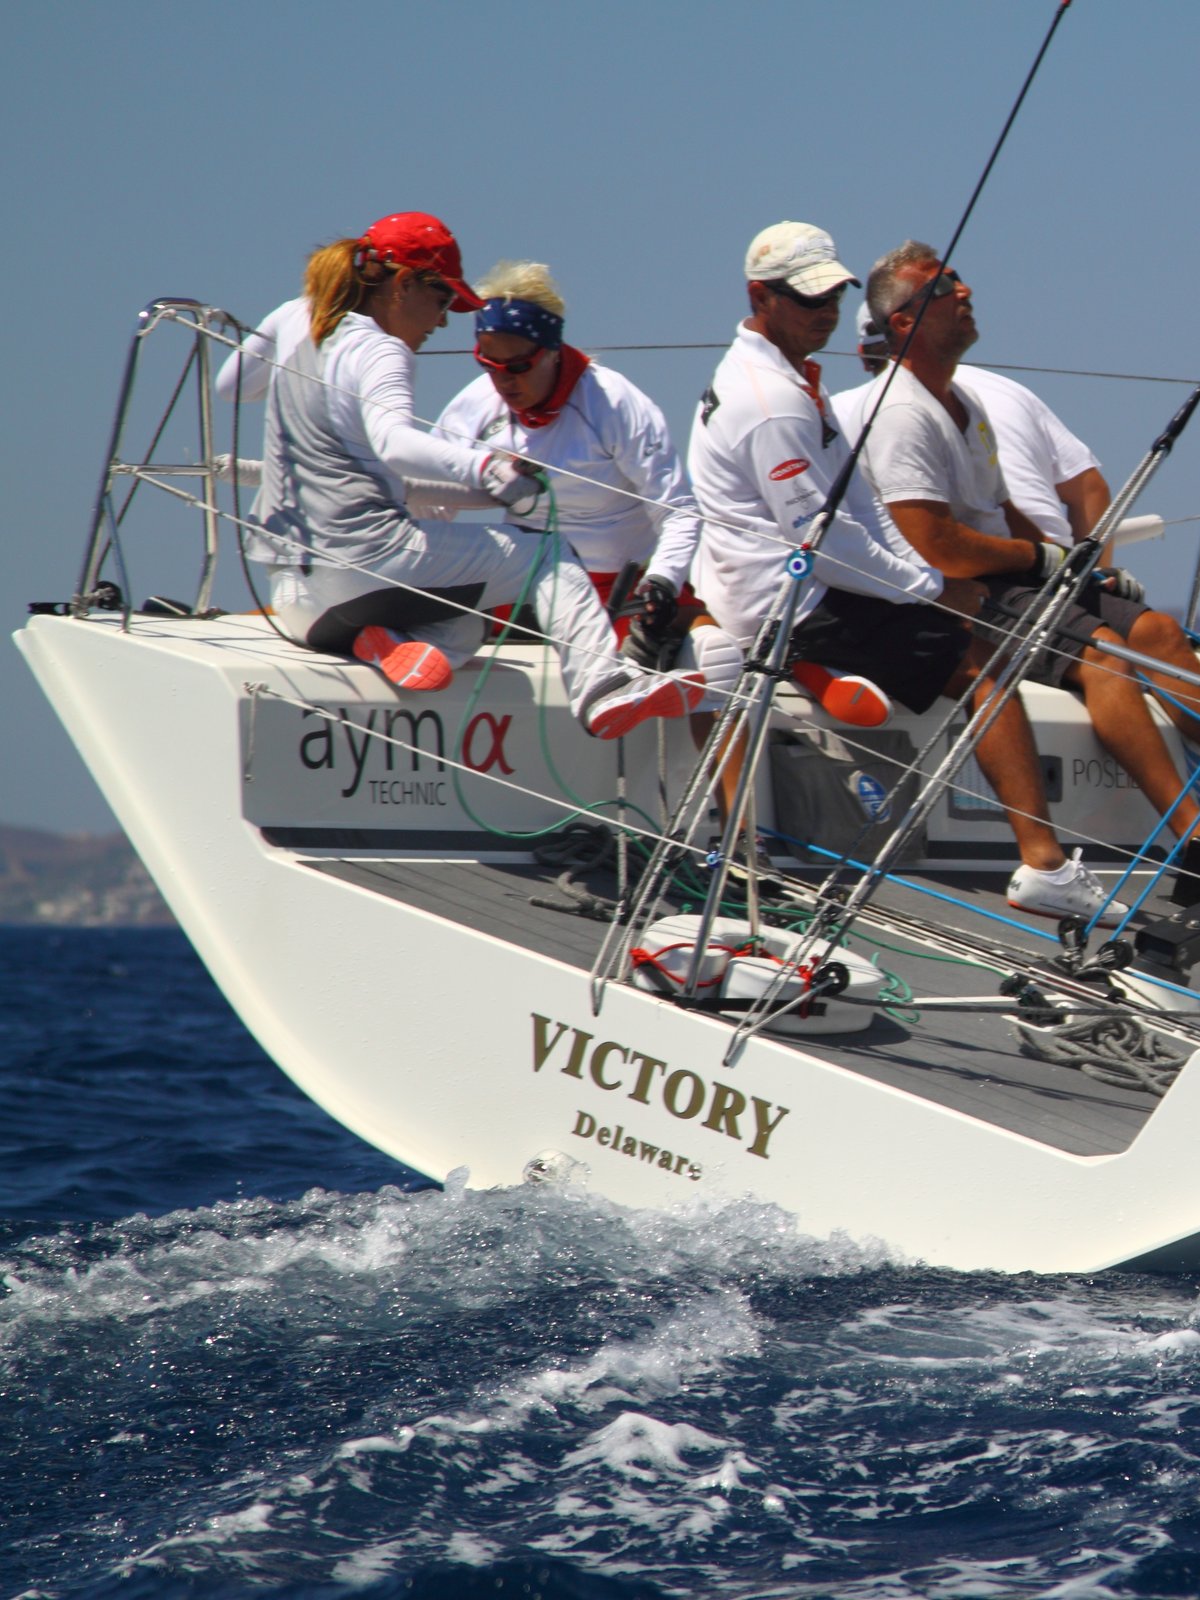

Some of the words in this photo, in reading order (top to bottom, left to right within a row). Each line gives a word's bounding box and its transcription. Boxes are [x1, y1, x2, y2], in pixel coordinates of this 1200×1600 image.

[368, 780, 447, 806] TECHNIC
[530, 1012, 790, 1159] VICTORY
[571, 1110, 702, 1181] Delaware
